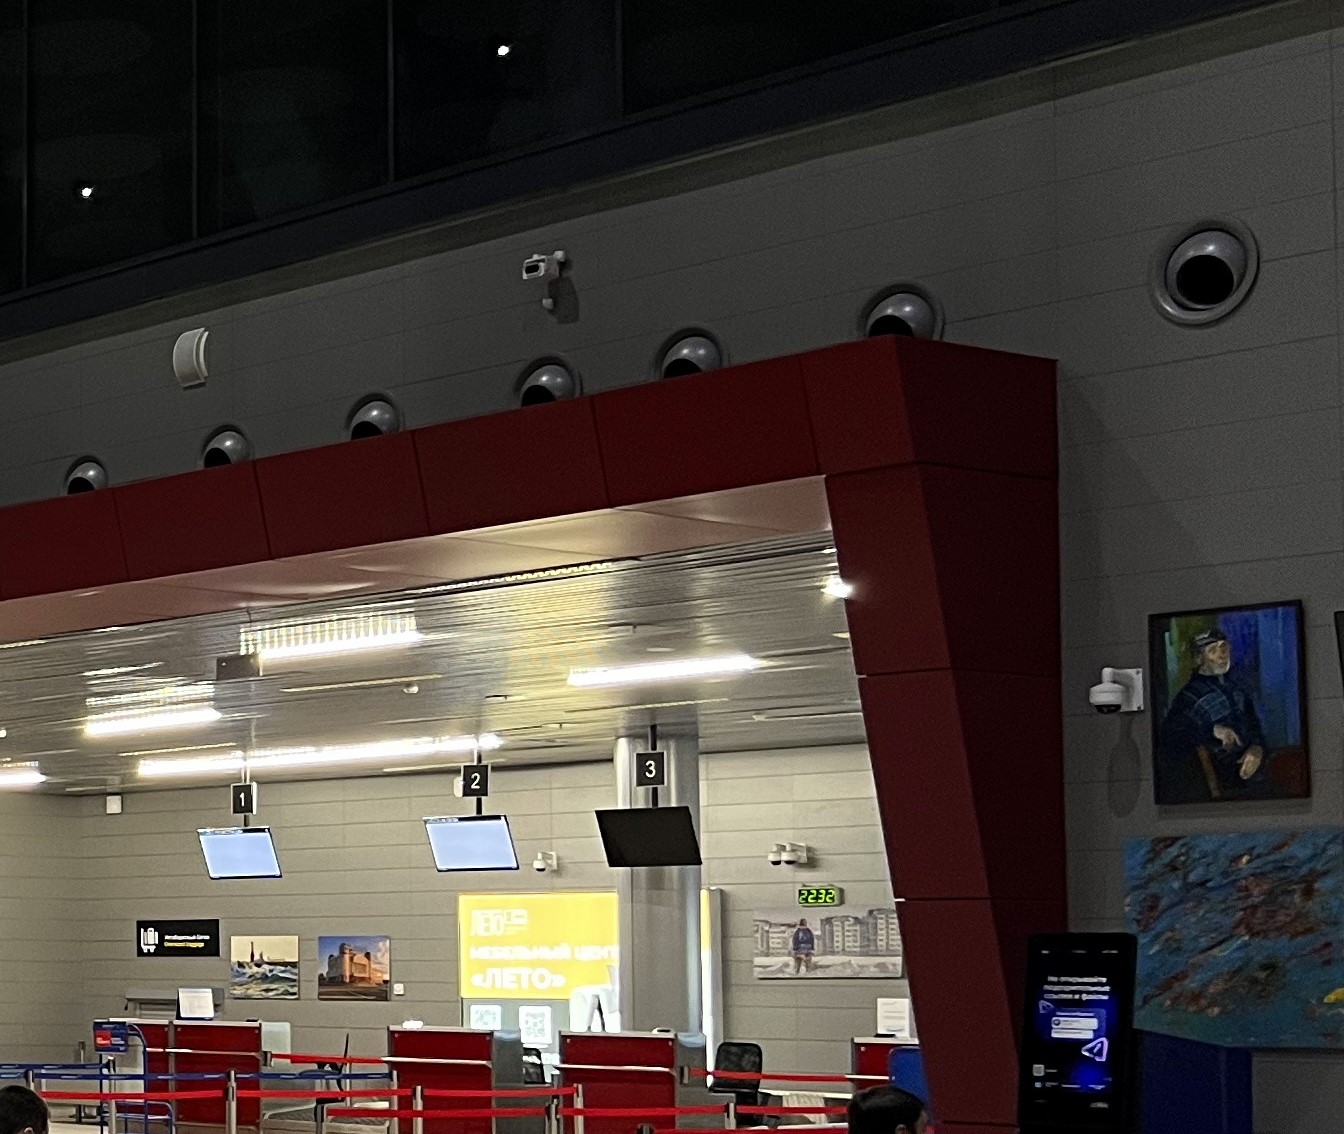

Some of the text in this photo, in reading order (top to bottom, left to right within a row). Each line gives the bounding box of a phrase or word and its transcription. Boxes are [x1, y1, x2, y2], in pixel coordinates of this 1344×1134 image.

[645, 760, 656, 778] 3
[470, 772, 481, 790] 2
[239, 792, 245, 807] 1
[574, 945, 619, 961] ЦЕНТ
[471, 967, 566, 990] «ЛЕТО»
